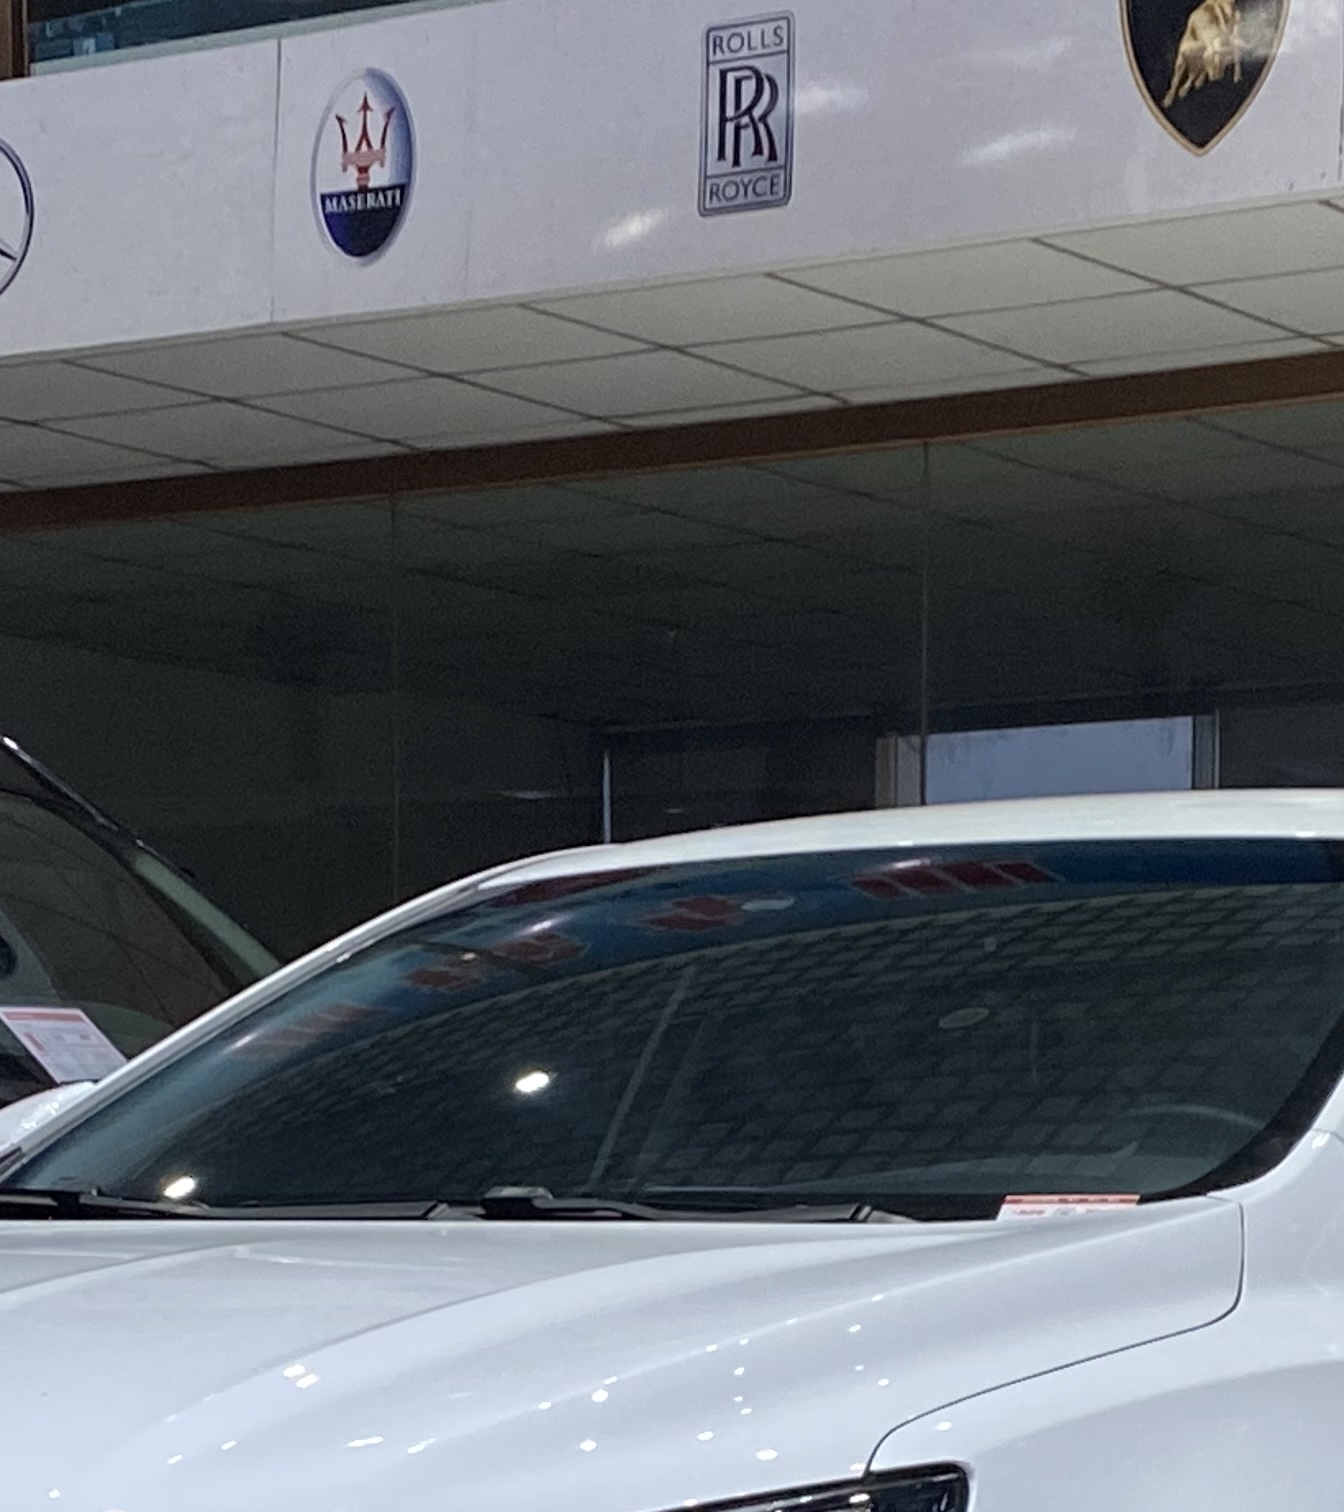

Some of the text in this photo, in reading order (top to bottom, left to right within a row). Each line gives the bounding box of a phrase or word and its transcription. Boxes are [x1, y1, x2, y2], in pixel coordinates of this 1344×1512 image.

[711, 25, 785, 57] ROLLS
[717, 65, 779, 168] RR
[324, 188, 401, 213] MASERATI
[708, 173, 782, 205] ROYCE
